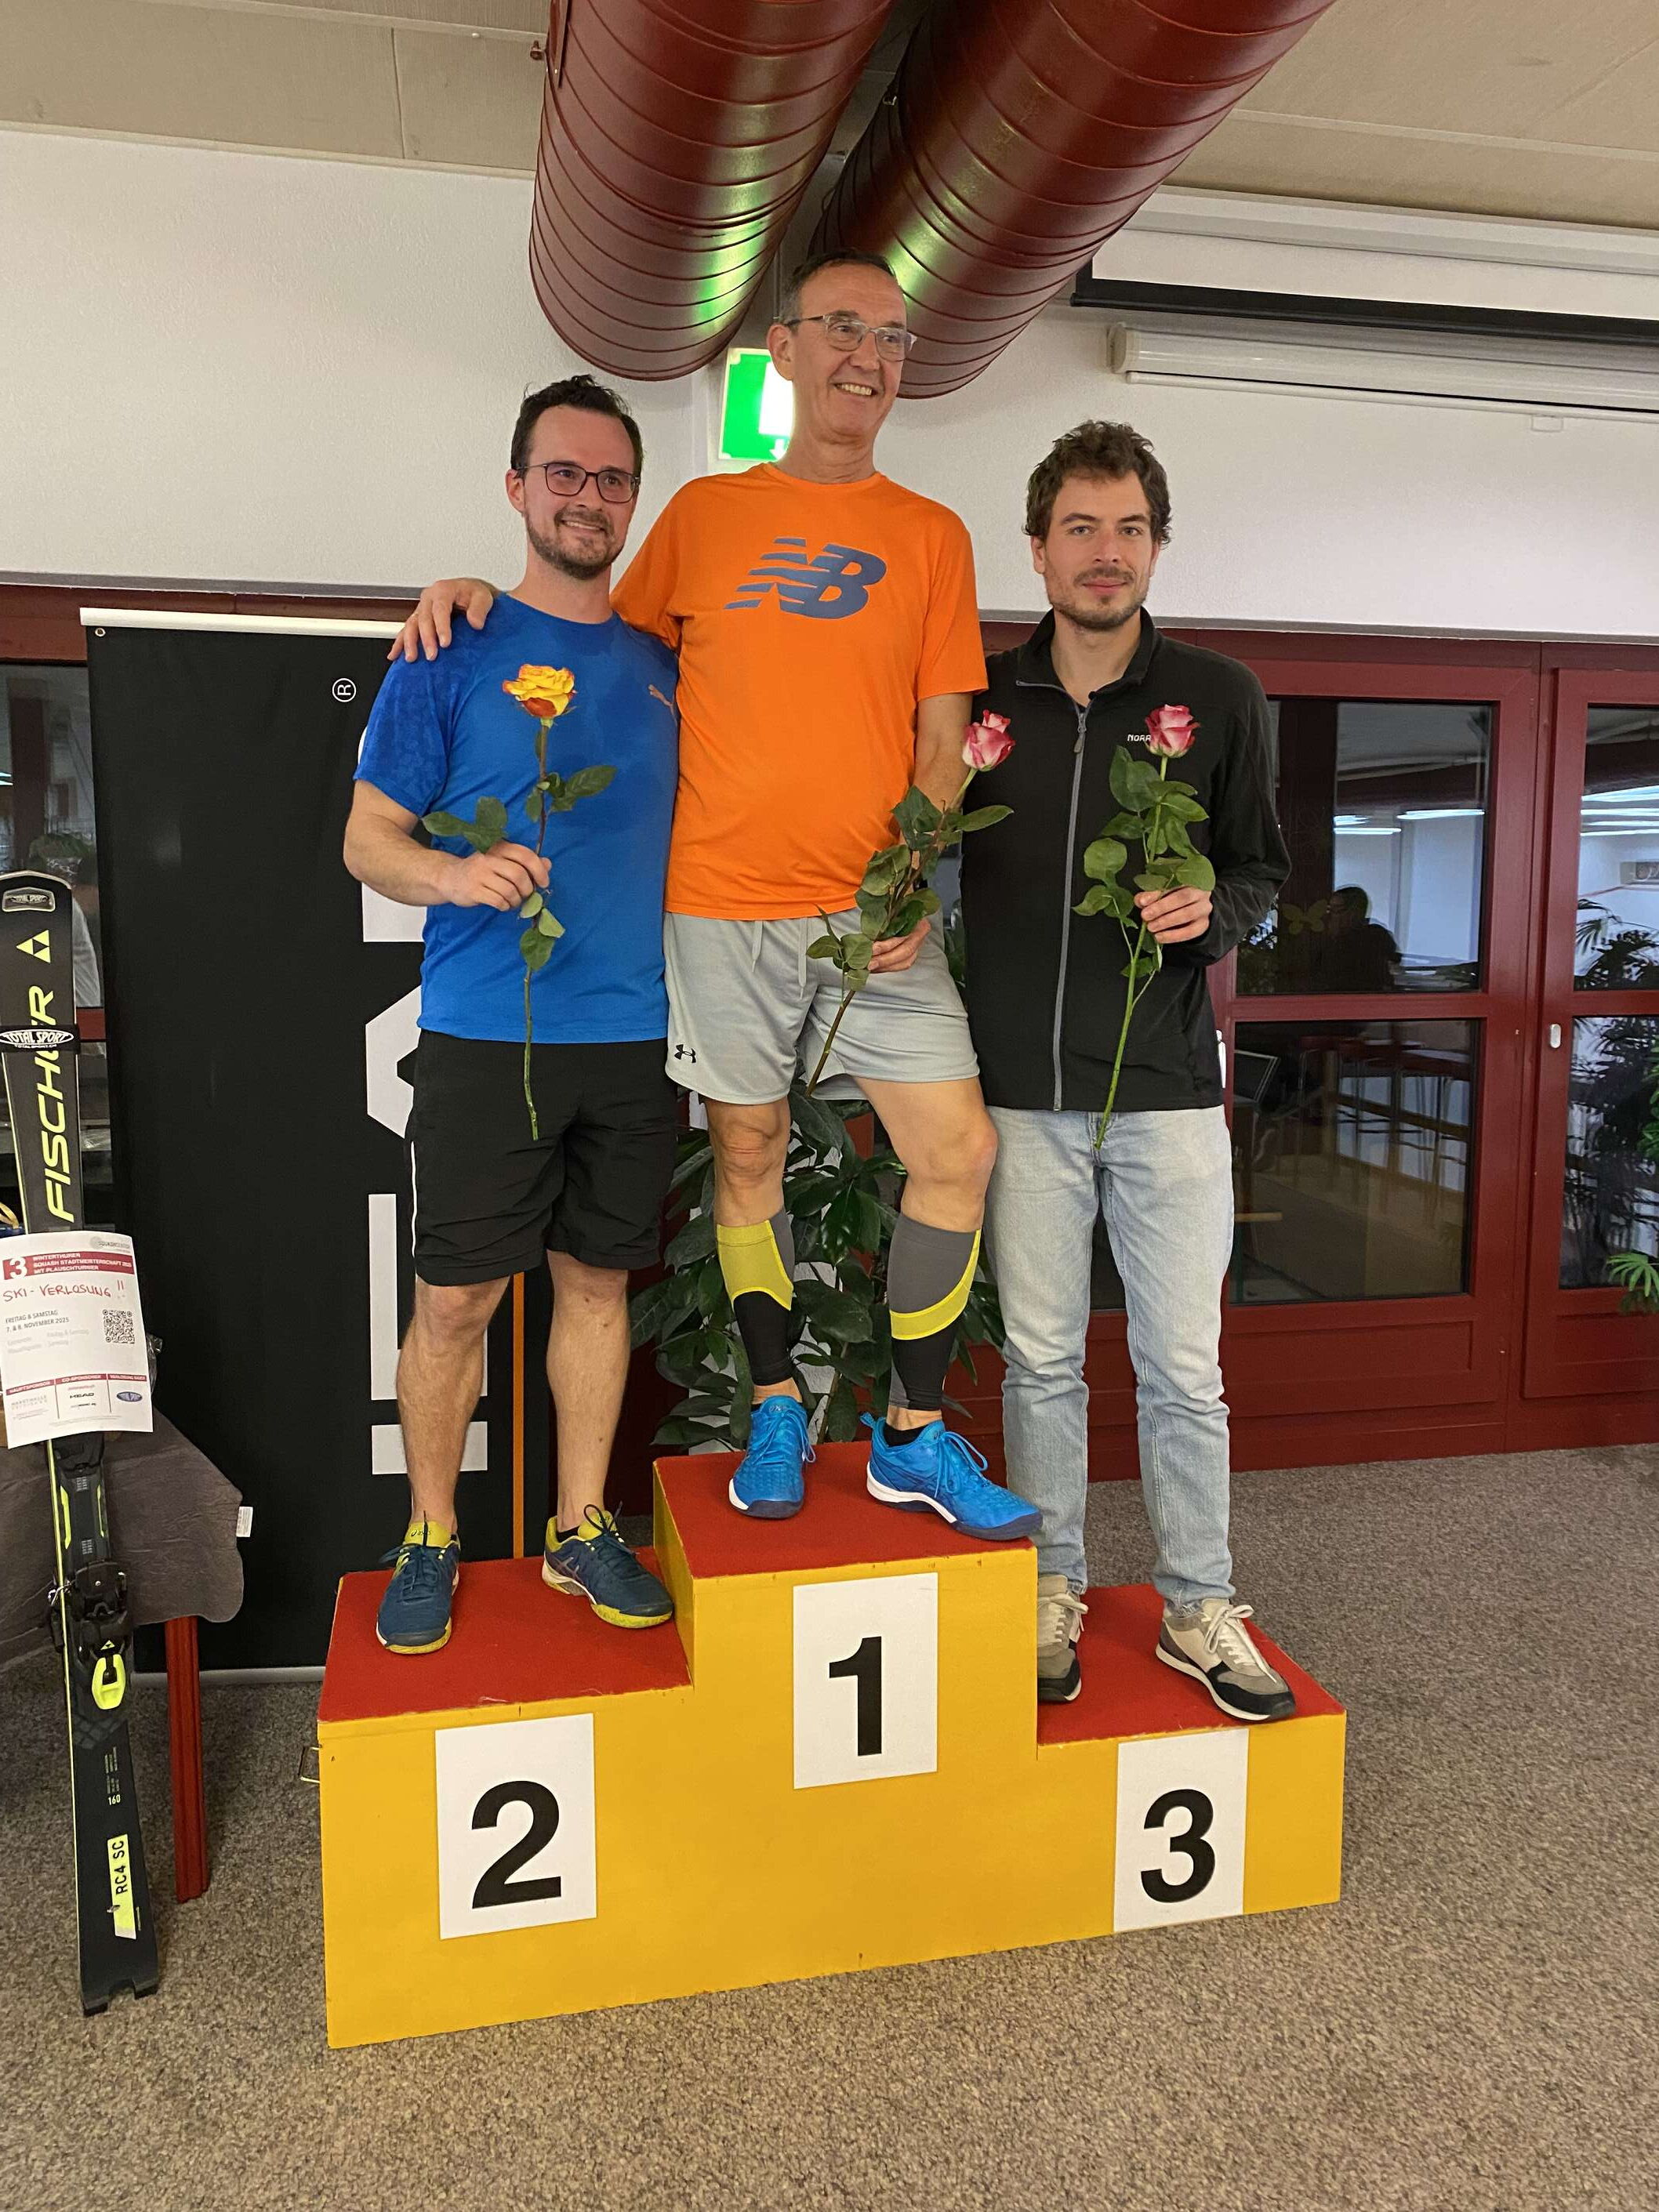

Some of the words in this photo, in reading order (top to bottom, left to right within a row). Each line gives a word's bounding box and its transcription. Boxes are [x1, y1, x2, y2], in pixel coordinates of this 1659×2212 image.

[2, 1031, 35, 1043] TOTAL
[36, 1031, 70, 1043] SPORT
[28, 985, 74, 1223] FISCHR
[39, 1284, 112, 1298] VERLOSUNG
[5, 1315, 27, 1323] FREITAG
[33, 1310, 59, 1318] SAMSTAG
[24, 1319, 54, 1329] NOVEMBER
[830, 1637, 881, 1756] 1
[108, 1794, 121, 1805] 160
[112, 1840, 125, 1858] SC
[472, 1781, 561, 1909] 2
[1141, 1790, 1214, 1902] 3
[115, 1865, 128, 1895] RC4
